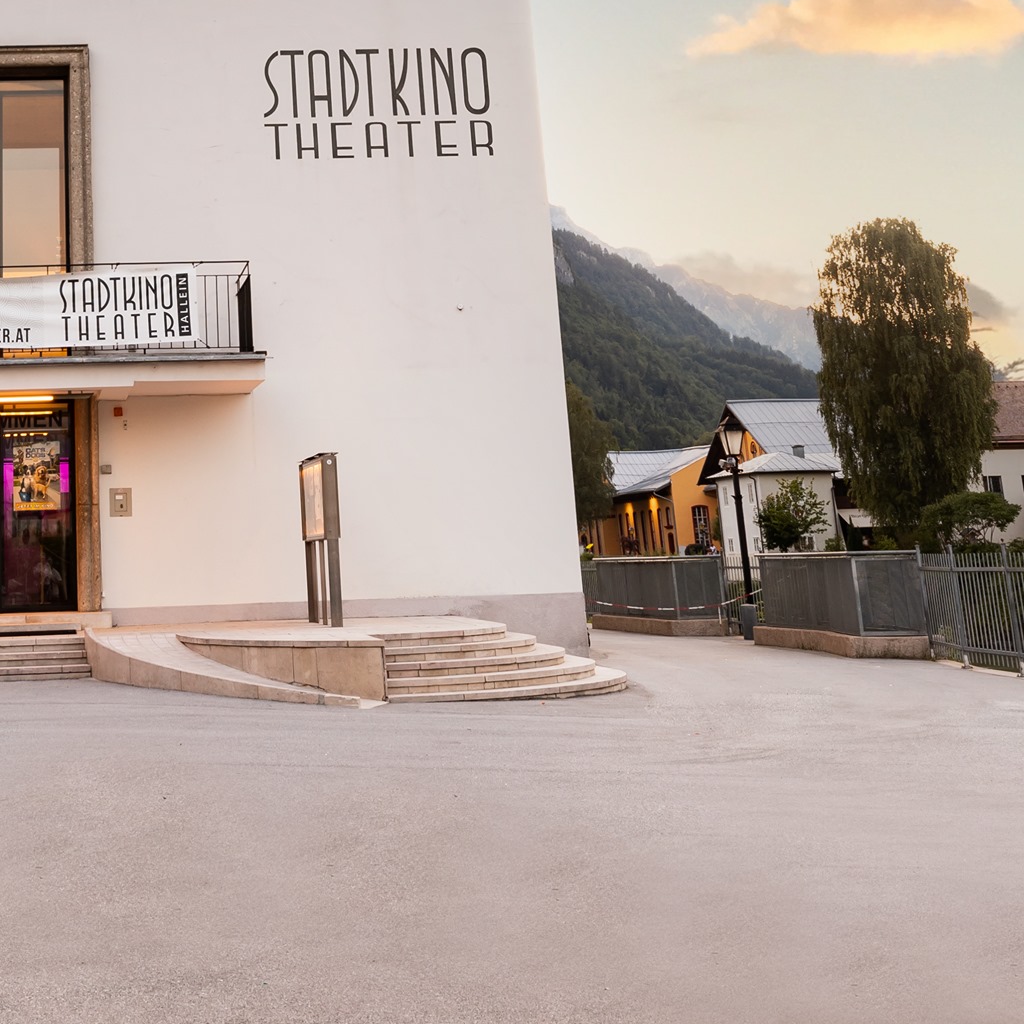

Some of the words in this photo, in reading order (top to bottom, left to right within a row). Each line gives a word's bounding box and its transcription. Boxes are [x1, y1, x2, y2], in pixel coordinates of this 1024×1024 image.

[263, 47, 491, 118] STADTKINO
[264, 120, 494, 160] THEATER
[59, 274, 174, 314] STADTKINO
[179, 276, 189, 335] HALLEIN
[61, 310, 176, 342] THEATER
